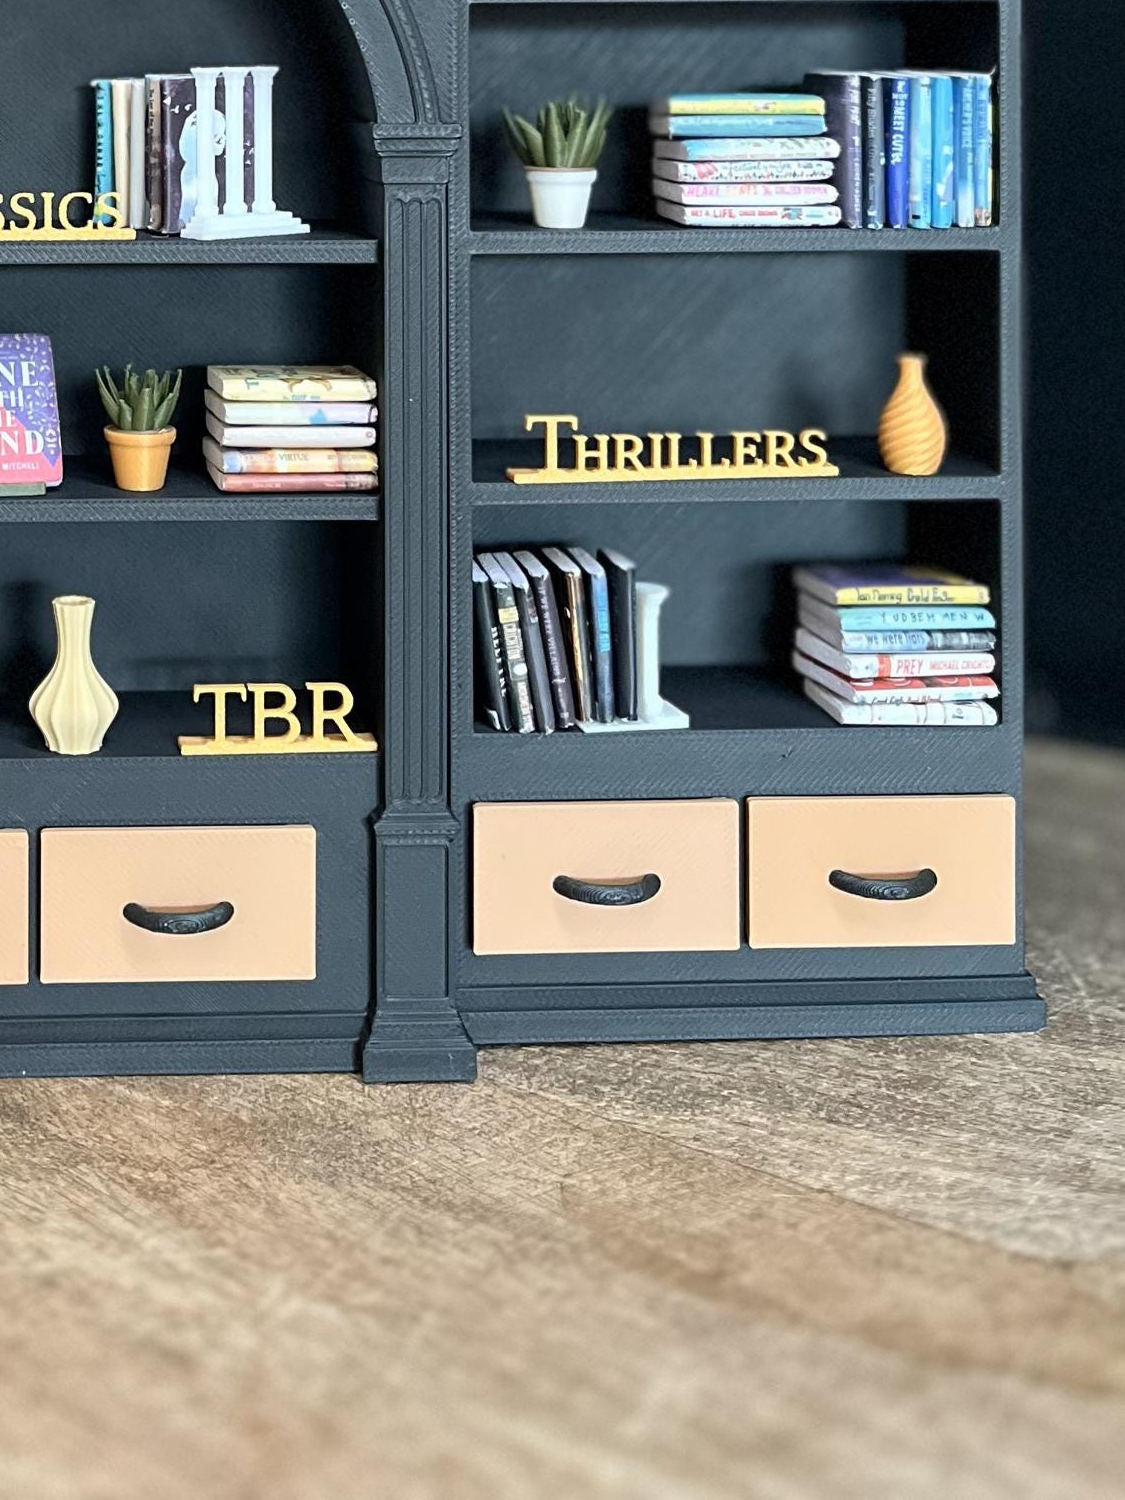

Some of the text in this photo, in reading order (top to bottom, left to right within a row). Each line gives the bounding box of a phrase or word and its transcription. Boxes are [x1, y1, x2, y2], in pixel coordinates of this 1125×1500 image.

[892, 107, 906, 131] MEET
[525, 414, 827, 470] THRILLERS
[896, 659, 923, 675] PREY
[193, 682, 363, 743] TBR
